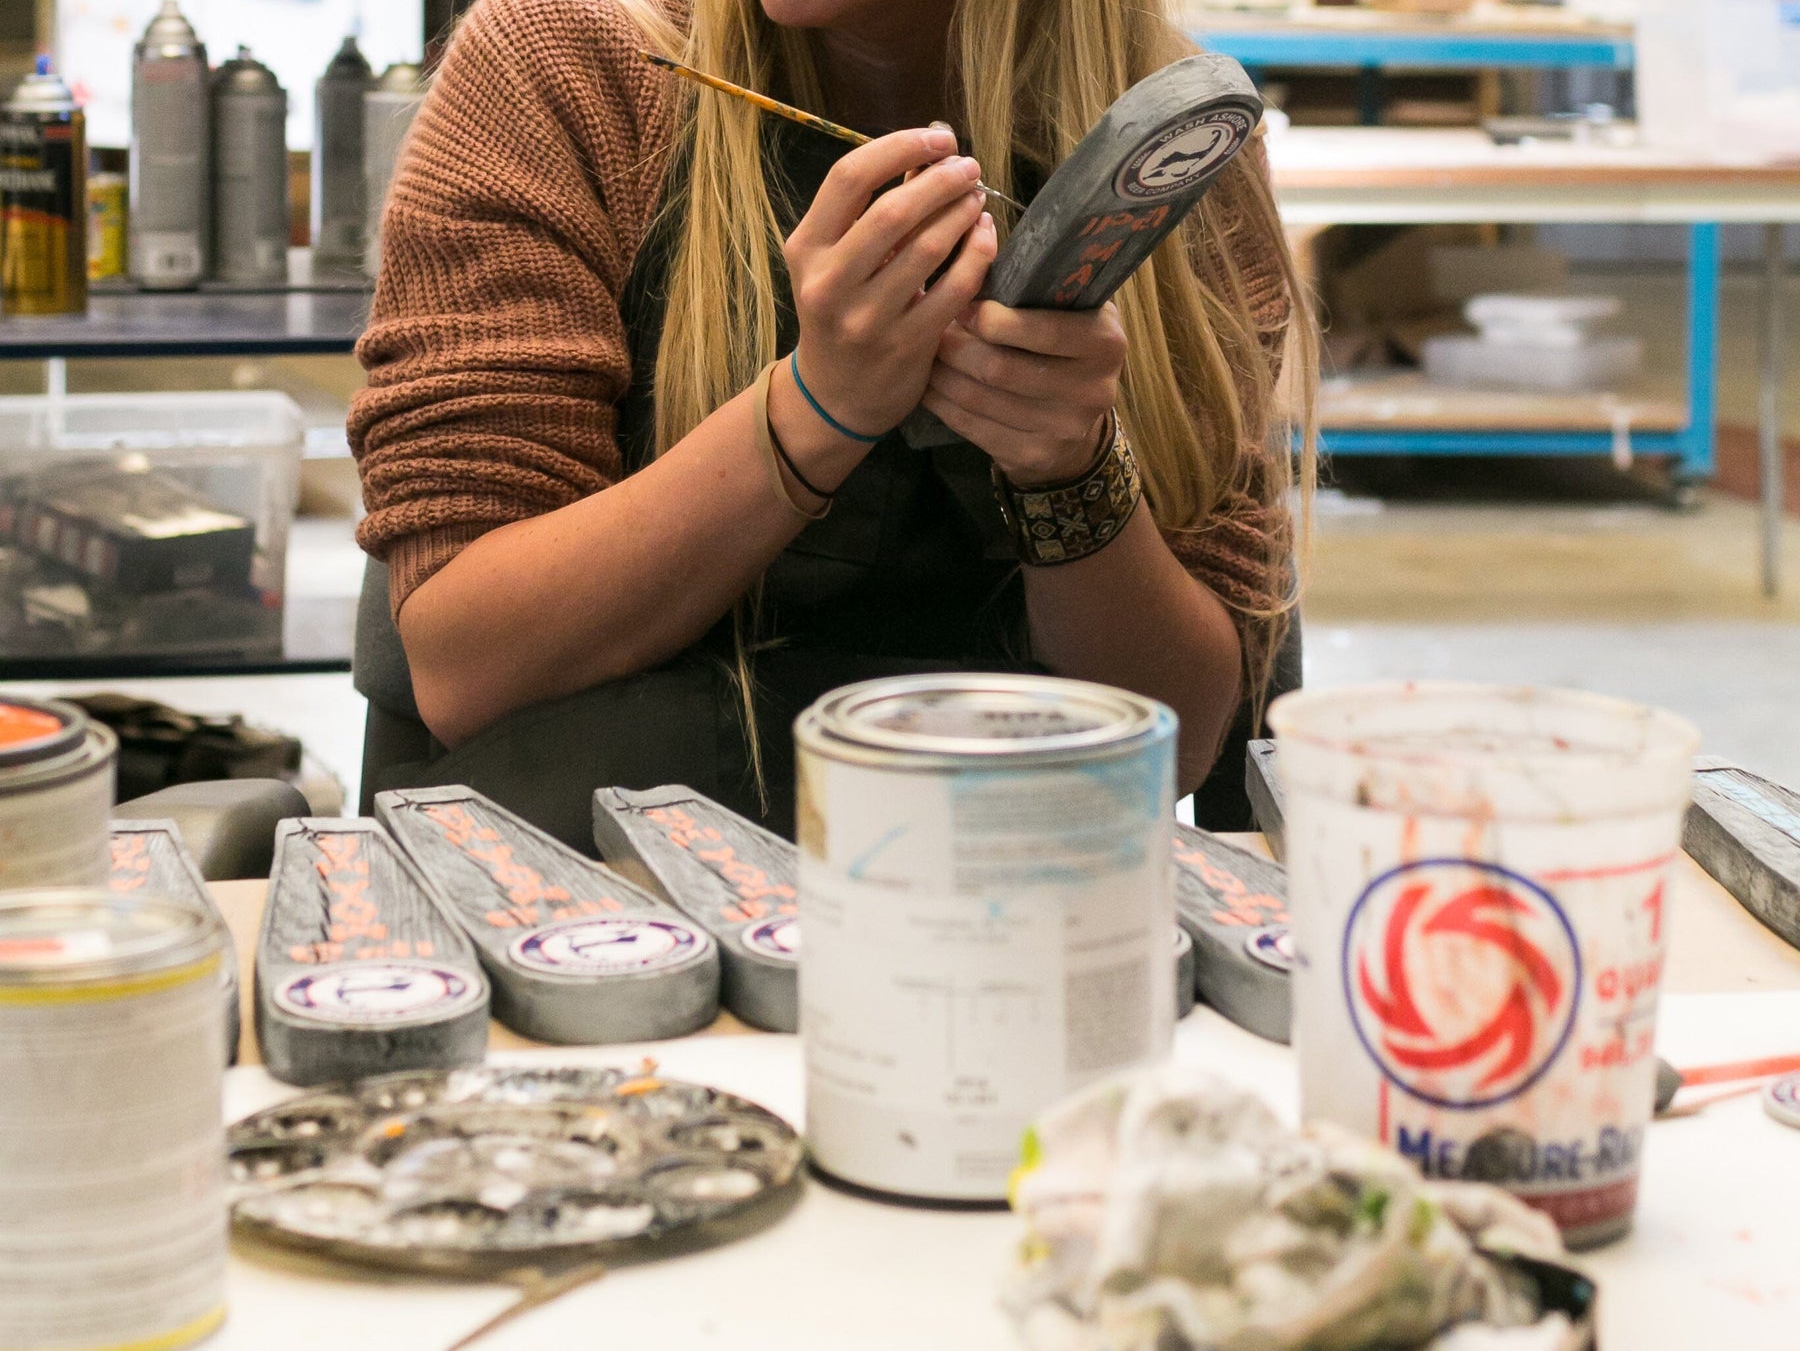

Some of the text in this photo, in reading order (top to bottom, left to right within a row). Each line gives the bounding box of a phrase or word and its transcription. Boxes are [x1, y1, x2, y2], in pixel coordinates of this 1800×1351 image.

[1159, 111, 1248, 143] WASH ASHORE
[1127, 172, 1201, 196] BEER COMPANY
